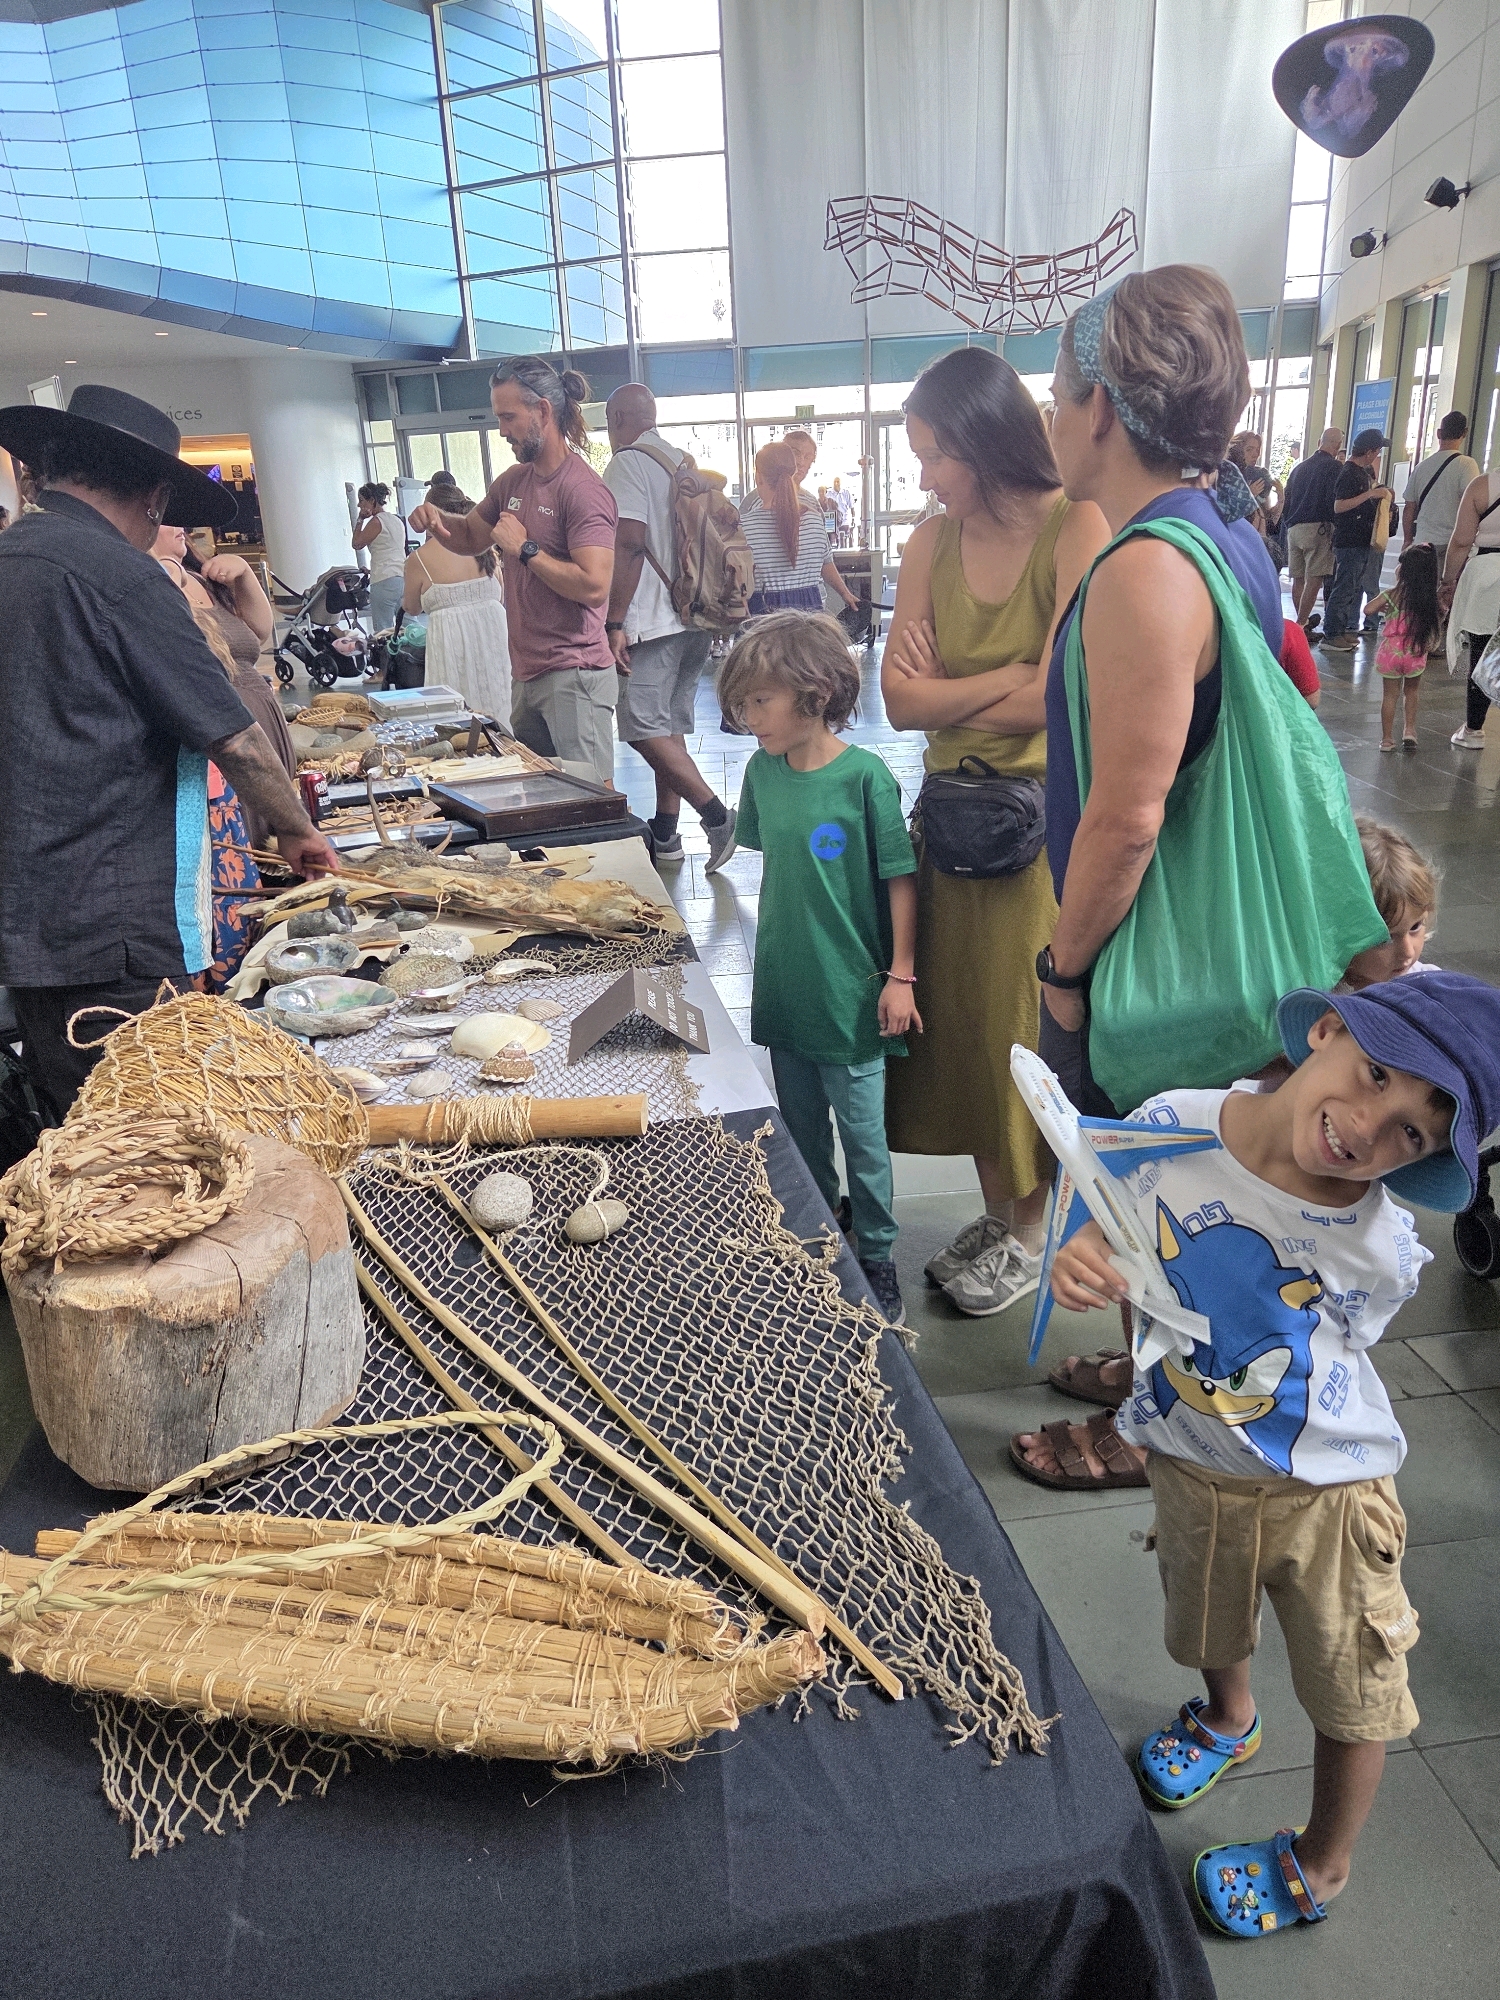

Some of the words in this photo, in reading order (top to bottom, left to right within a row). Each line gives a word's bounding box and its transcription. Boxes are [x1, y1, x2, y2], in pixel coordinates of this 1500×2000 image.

[1357, 400, 1375, 409] PLEASE
[1375, 399, 1390, 408] ENJOY
[797, 406, 813, 418] EXIT
[1358, 410, 1385, 420] ALCOHOLIC
[537, 505, 555, 517] RVCA
[646, 987, 657, 1010] PLEASE
[665, 990, 676, 1011] TOUCH
[667, 1008, 678, 1023] NOT
[686, 1010, 696, 1023] YOU
[668, 1021, 679, 1033] DO
[687, 1021, 699, 1042] THANK
[1091, 1134, 1119, 1145] POWER
[1058, 1173, 1071, 1212] POWE
[1318, 1360, 1349, 1411] GO
[1321, 1437, 1370, 1465] SONIC
